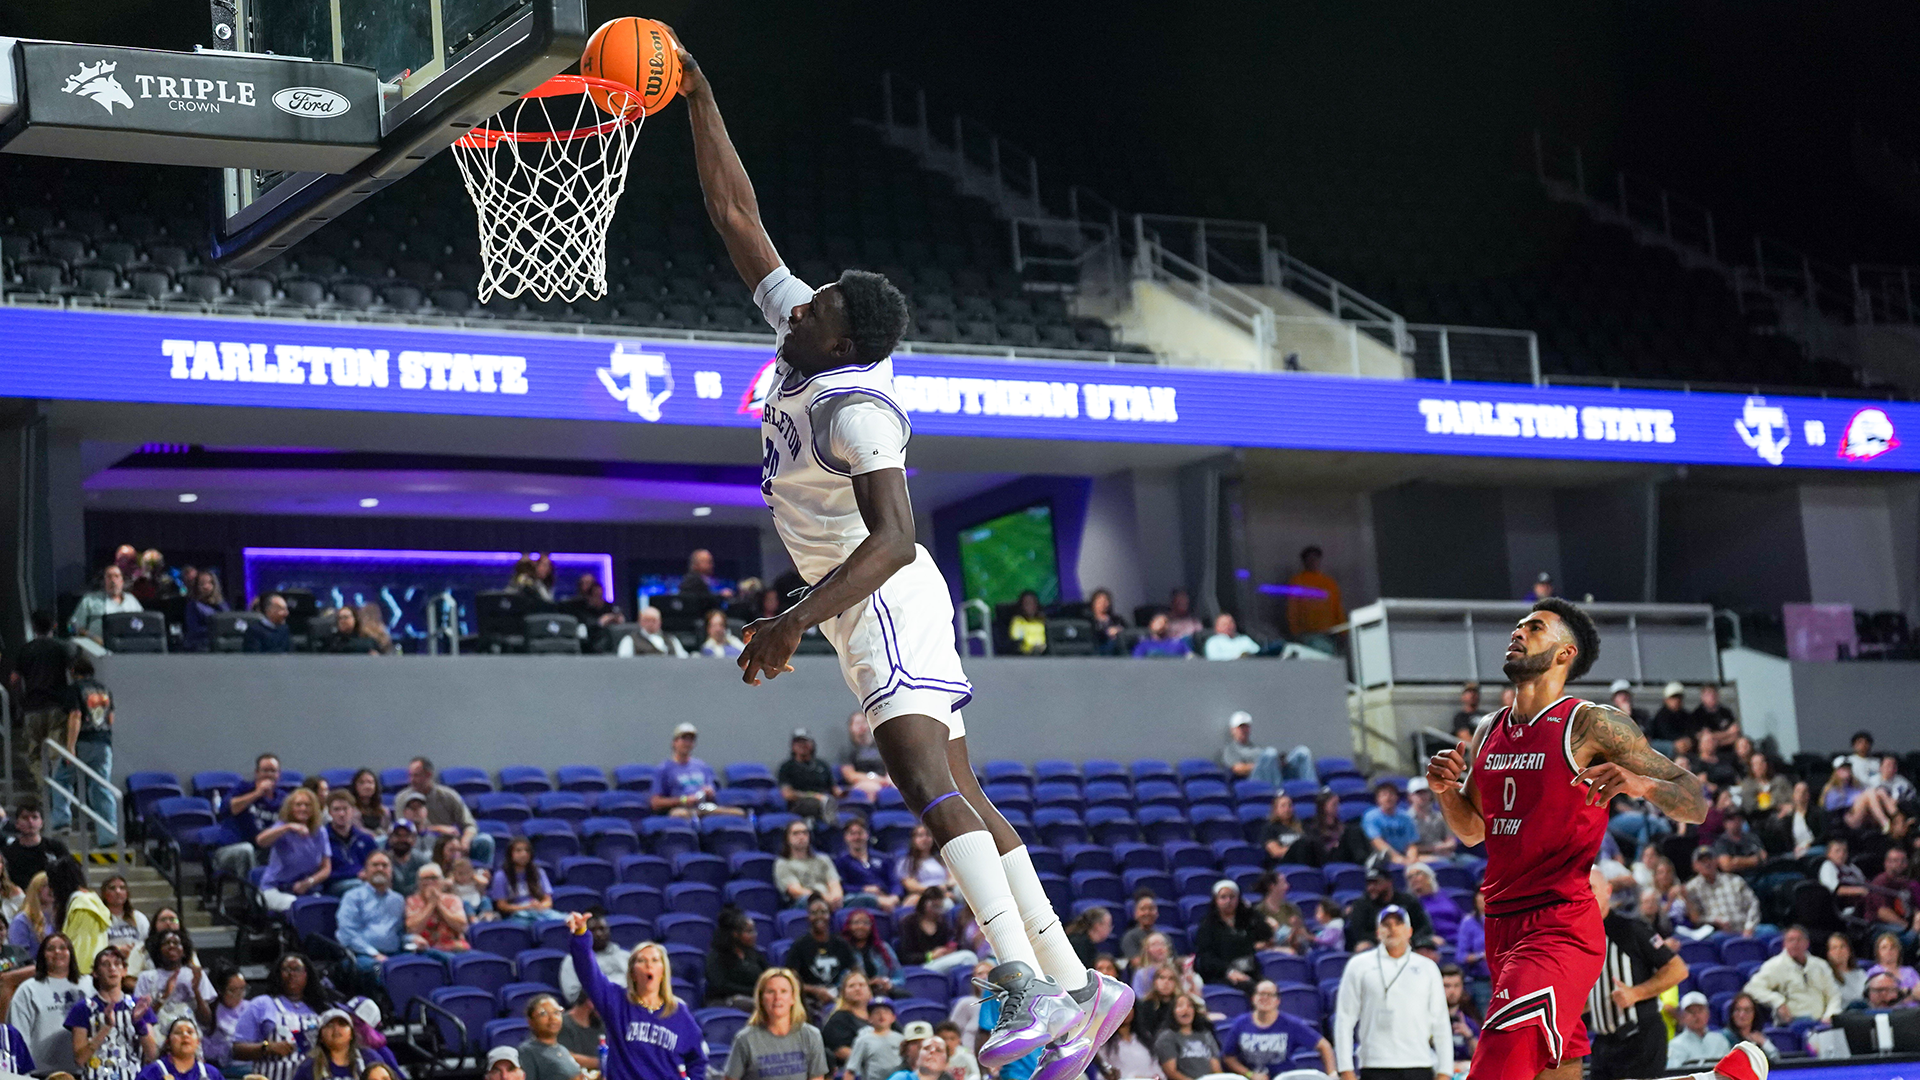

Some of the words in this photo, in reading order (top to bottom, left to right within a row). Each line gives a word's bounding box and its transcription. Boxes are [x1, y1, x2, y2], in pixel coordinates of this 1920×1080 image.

[645, 30, 664, 96] Wilson
[135, 74, 256, 107] TRIPLE
[168, 99, 221, 113] CROWN
[288, 91, 335, 113] Ford
[161, 339, 390, 388] TARLETON
[398, 350, 528, 394] STATE
[894, 375, 1079, 418] SOUTHERN
[1083, 384, 1178, 422] UTAH
[762, 403, 802, 462] RLETON
[1418, 398, 1579, 439] TARLETON
[1581, 406, 1676, 443] STATE
[1484, 753, 1545, 770] SOUTHERN
[1503, 776, 1517, 811] 0
[1491, 818, 1522, 835] UTAH
[625, 1022, 678, 1052] TARLETON
